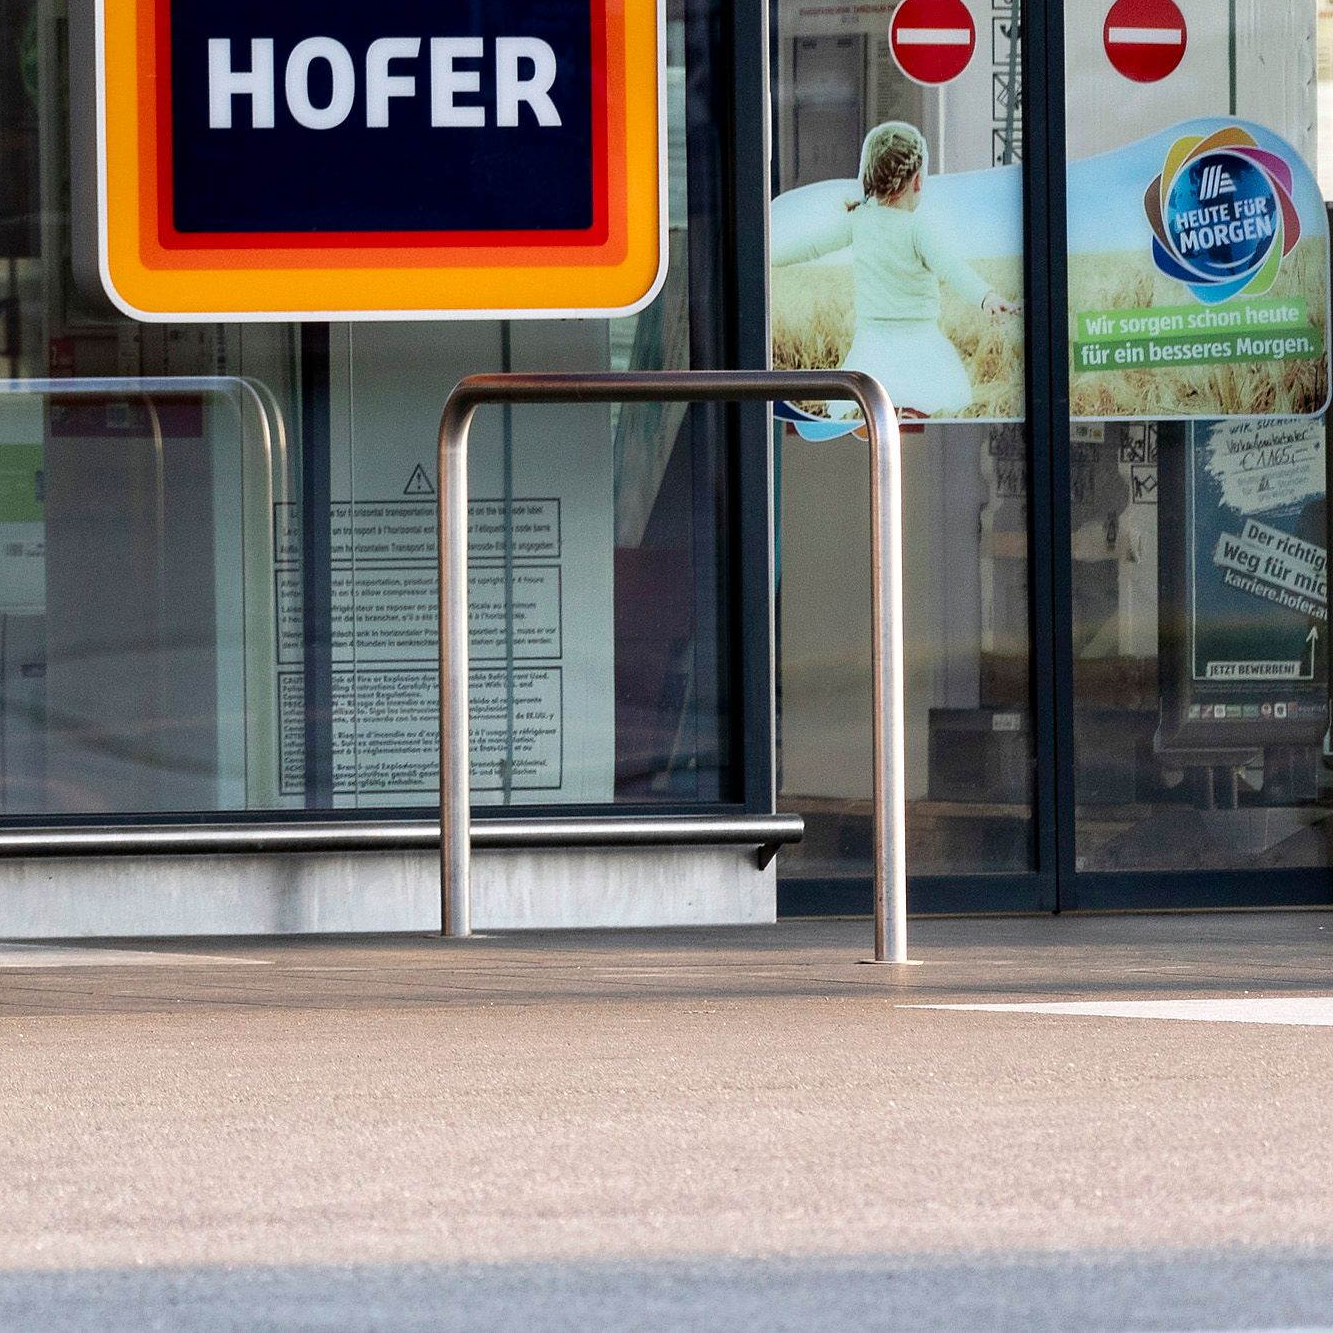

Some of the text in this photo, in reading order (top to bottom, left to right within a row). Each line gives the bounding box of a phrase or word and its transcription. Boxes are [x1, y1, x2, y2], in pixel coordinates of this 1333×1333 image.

[207, 36, 563, 130] HOFER
[1174, 196, 1267, 232] HEUTE FÜR
[1179, 215, 1272, 254] MORGEN
[1085, 305, 1299, 338] Wir sorgen schon heute
[1081, 333, 1315, 365] für ein besseres Morgen.
[1247, 525, 1327, 572] Der richtig
[1224, 542, 1327, 597] Weg für mic
